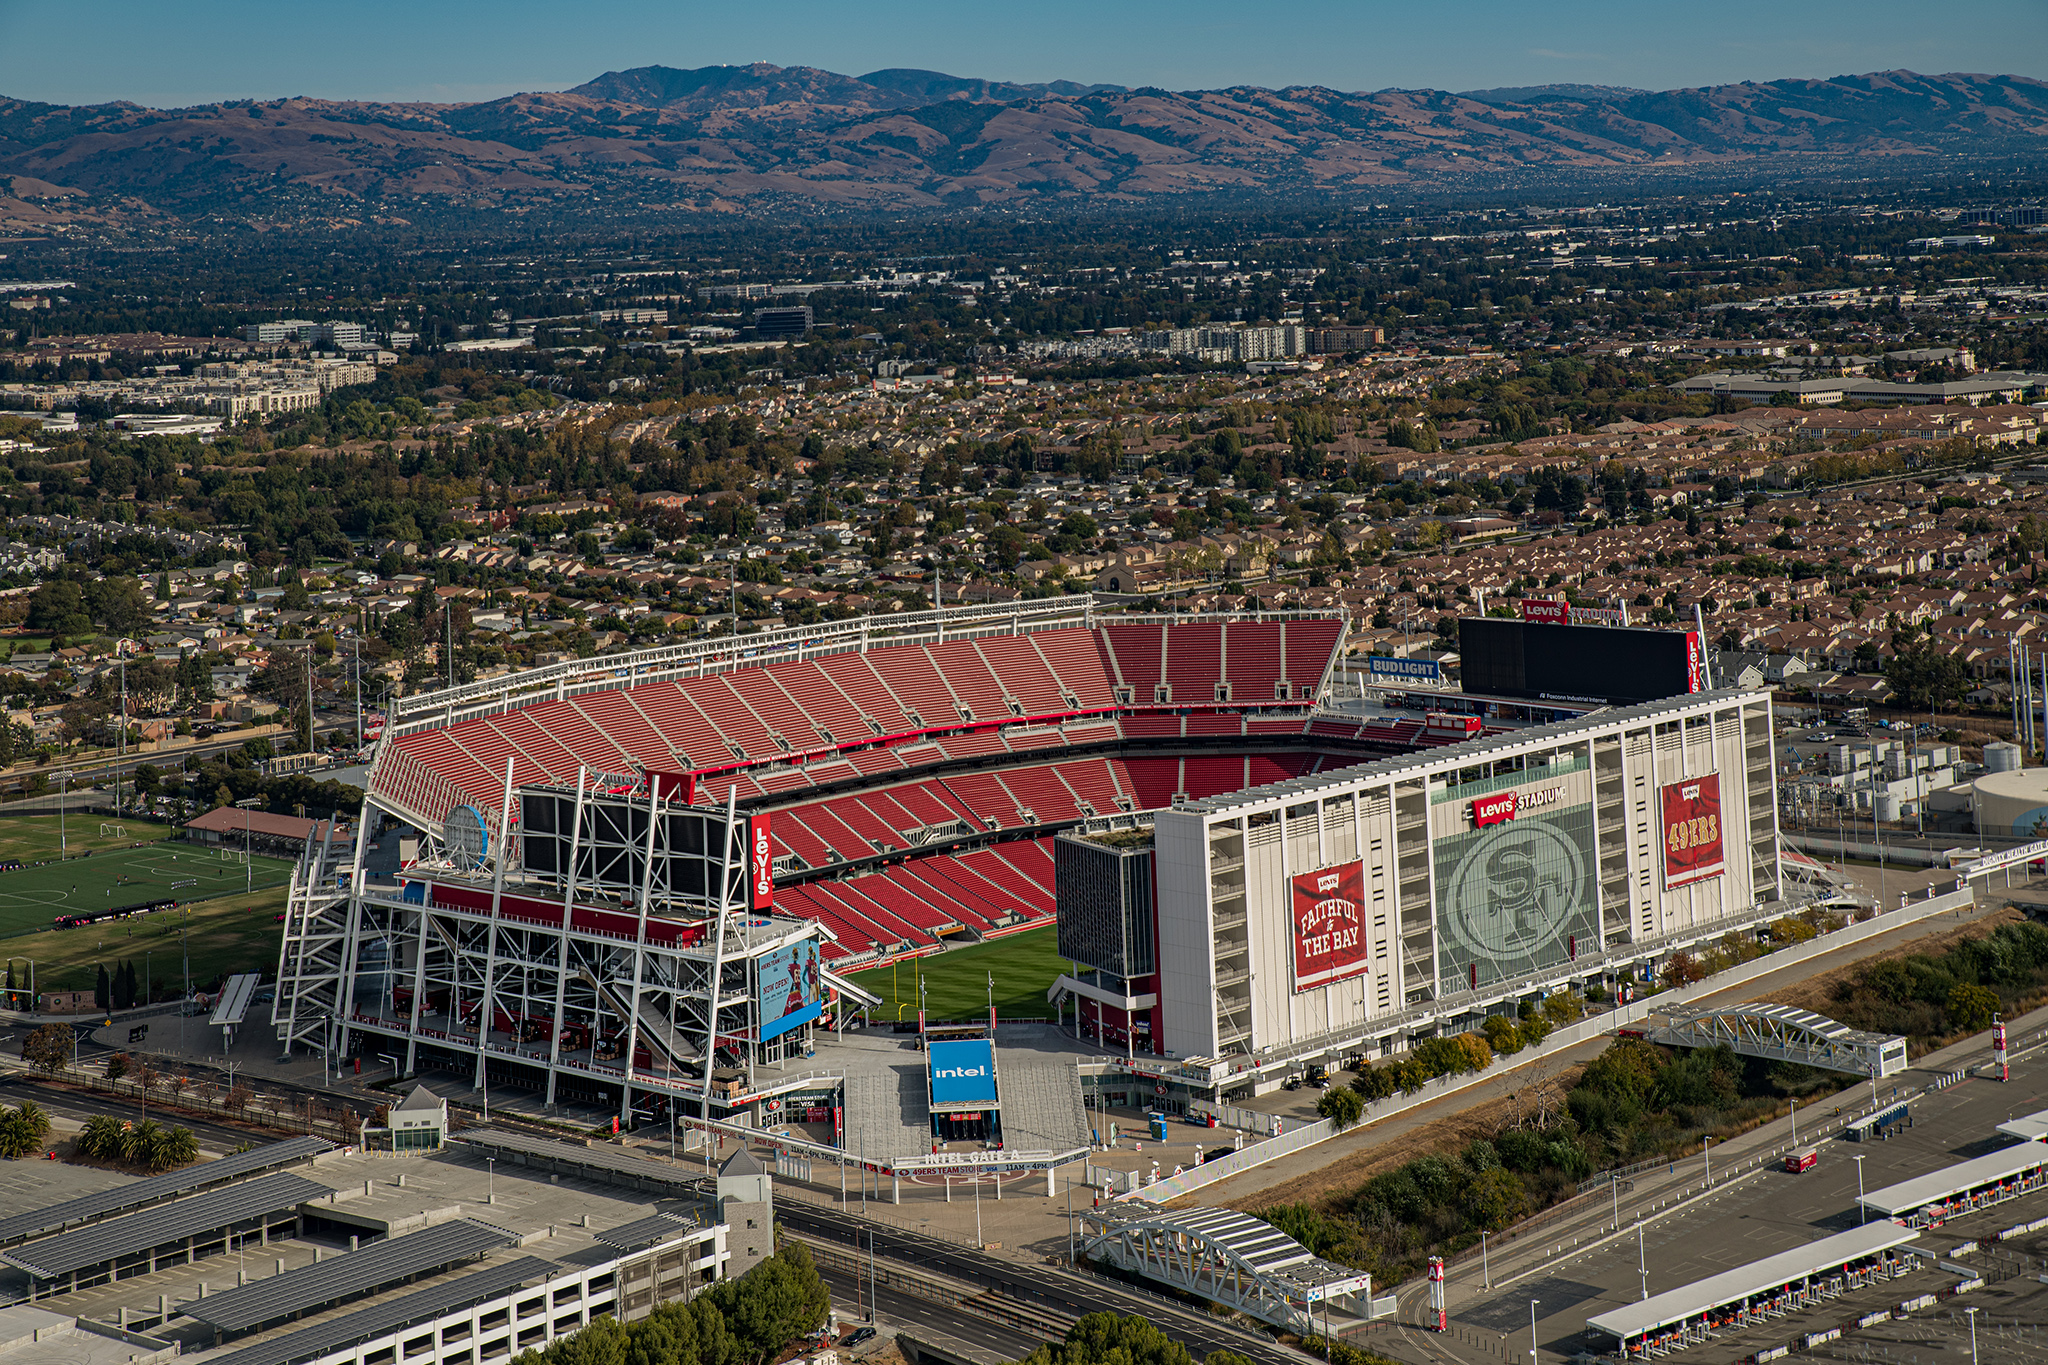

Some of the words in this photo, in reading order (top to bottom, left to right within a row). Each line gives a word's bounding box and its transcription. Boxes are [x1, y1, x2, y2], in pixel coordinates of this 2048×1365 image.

[1568, 607, 1620, 621] STADIUM
[1518, 786, 1566, 810] STADIUM
[1668, 814, 1718, 852] 49ERS
[1983, 851, 2007, 866] DIGNITY
[2007, 846, 2029, 860] HEALTH
[2030, 841, 2046, 853] GATE
[1301, 898, 1359, 937] FAITHFUL
[1326, 918, 1334, 932] to
[1302, 933, 1331, 958] THE
[1332, 926, 1359, 951] BAY
[1994, 1029, 2001, 1039] B
[2001, 1029, 2006, 1039] B
[755, 1137, 766, 1145] NOW
[790, 1145, 805, 1154] 11AM
[821, 1153, 837, 1162] THUR
[925, 1153, 964, 1164] INTEL
[970, 1150, 1004, 1163] GATE
[1010, 1149, 1020, 1160] A
[1005, 1163, 1025, 1171] 11AM
[1053, 1156, 1069, 1168] THUR
[1073, 1151, 1087, 1161] MON
[912, 1167, 937, 1176] 49ERS
[937, 1166, 960, 1175] TEAM
[960, 1164, 983, 1173] STORE
[1428, 1266, 1437, 1278] A
[1438, 1265, 1444, 1279] A
